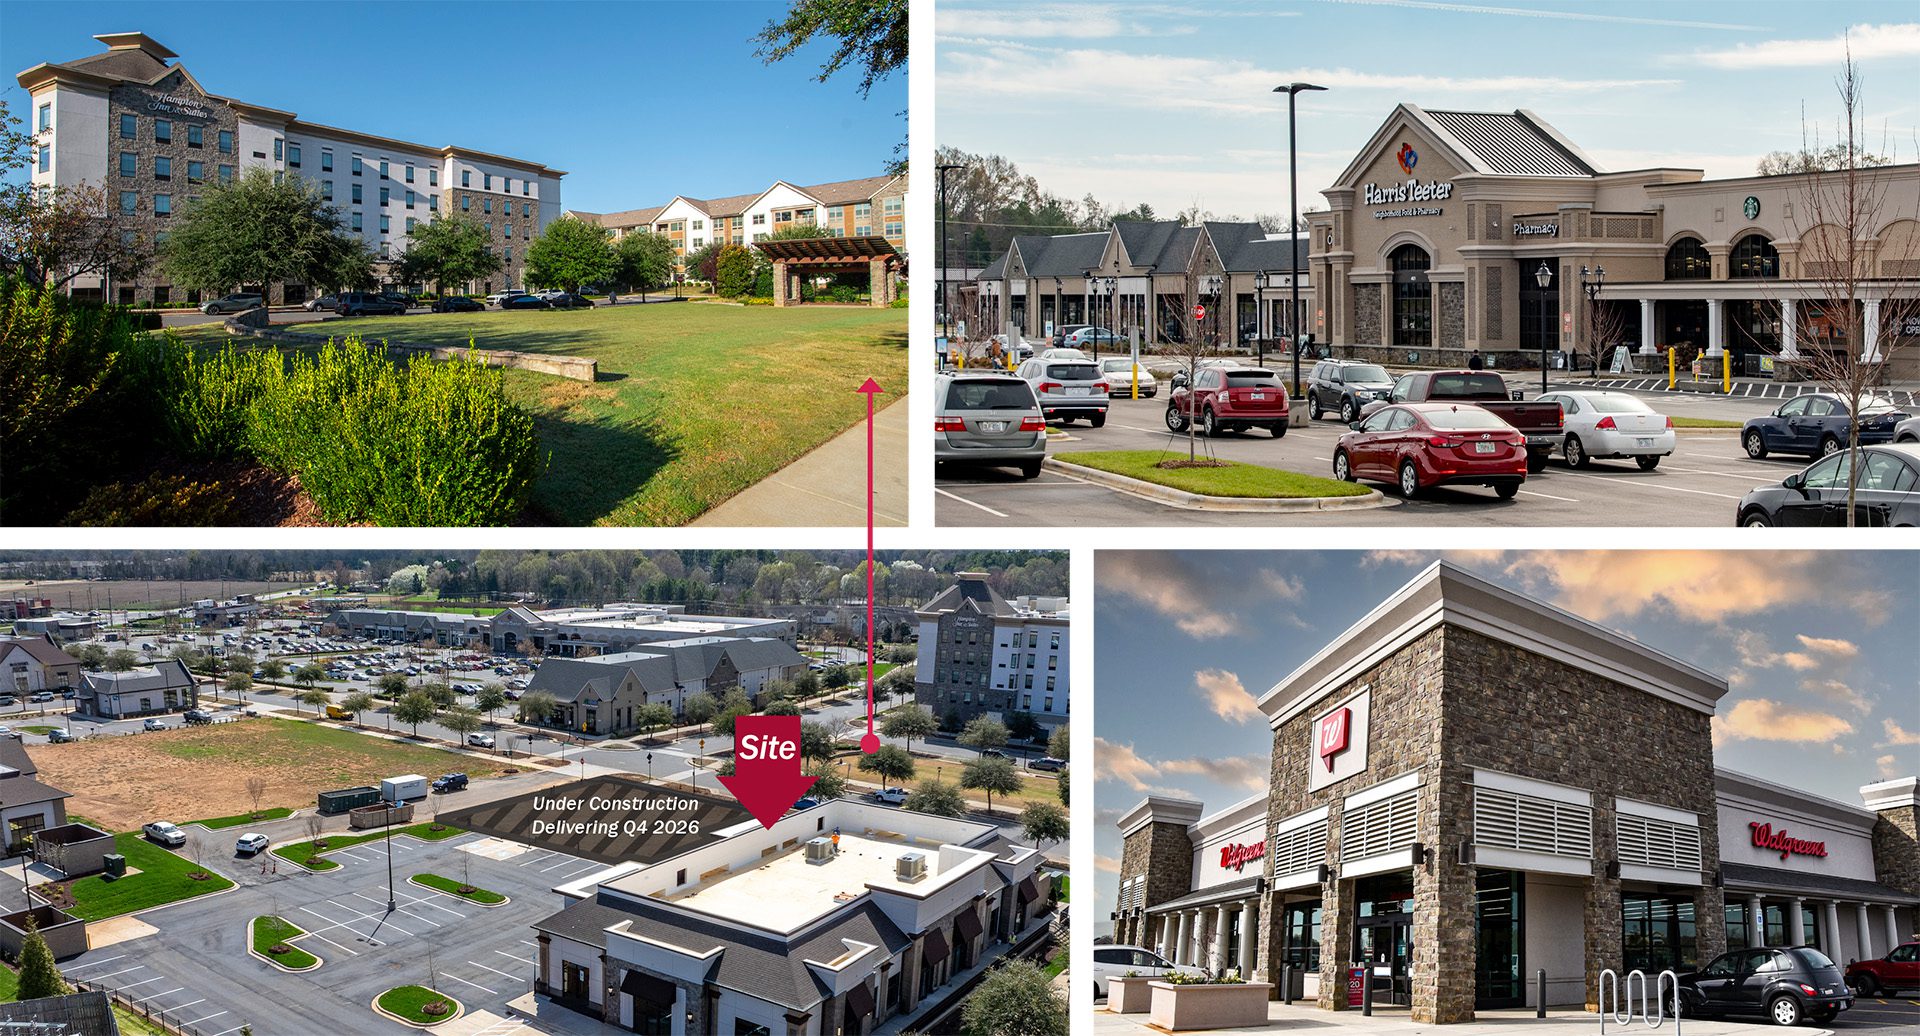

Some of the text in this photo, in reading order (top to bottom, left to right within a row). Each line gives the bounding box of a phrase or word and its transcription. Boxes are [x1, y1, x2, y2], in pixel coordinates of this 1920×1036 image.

[148, 102, 174, 113] Inn
[182, 106, 208, 119] Suites
[152, 93, 204, 110] Hampton
[1364, 179, 1452, 205] Harris Teeter
[1513, 223, 1558, 237] Pharmacy
[1323, 714, 1343, 749] W
[1748, 821, 1828, 860] Walgreens
[1220, 841, 1266, 872] Walgreen
